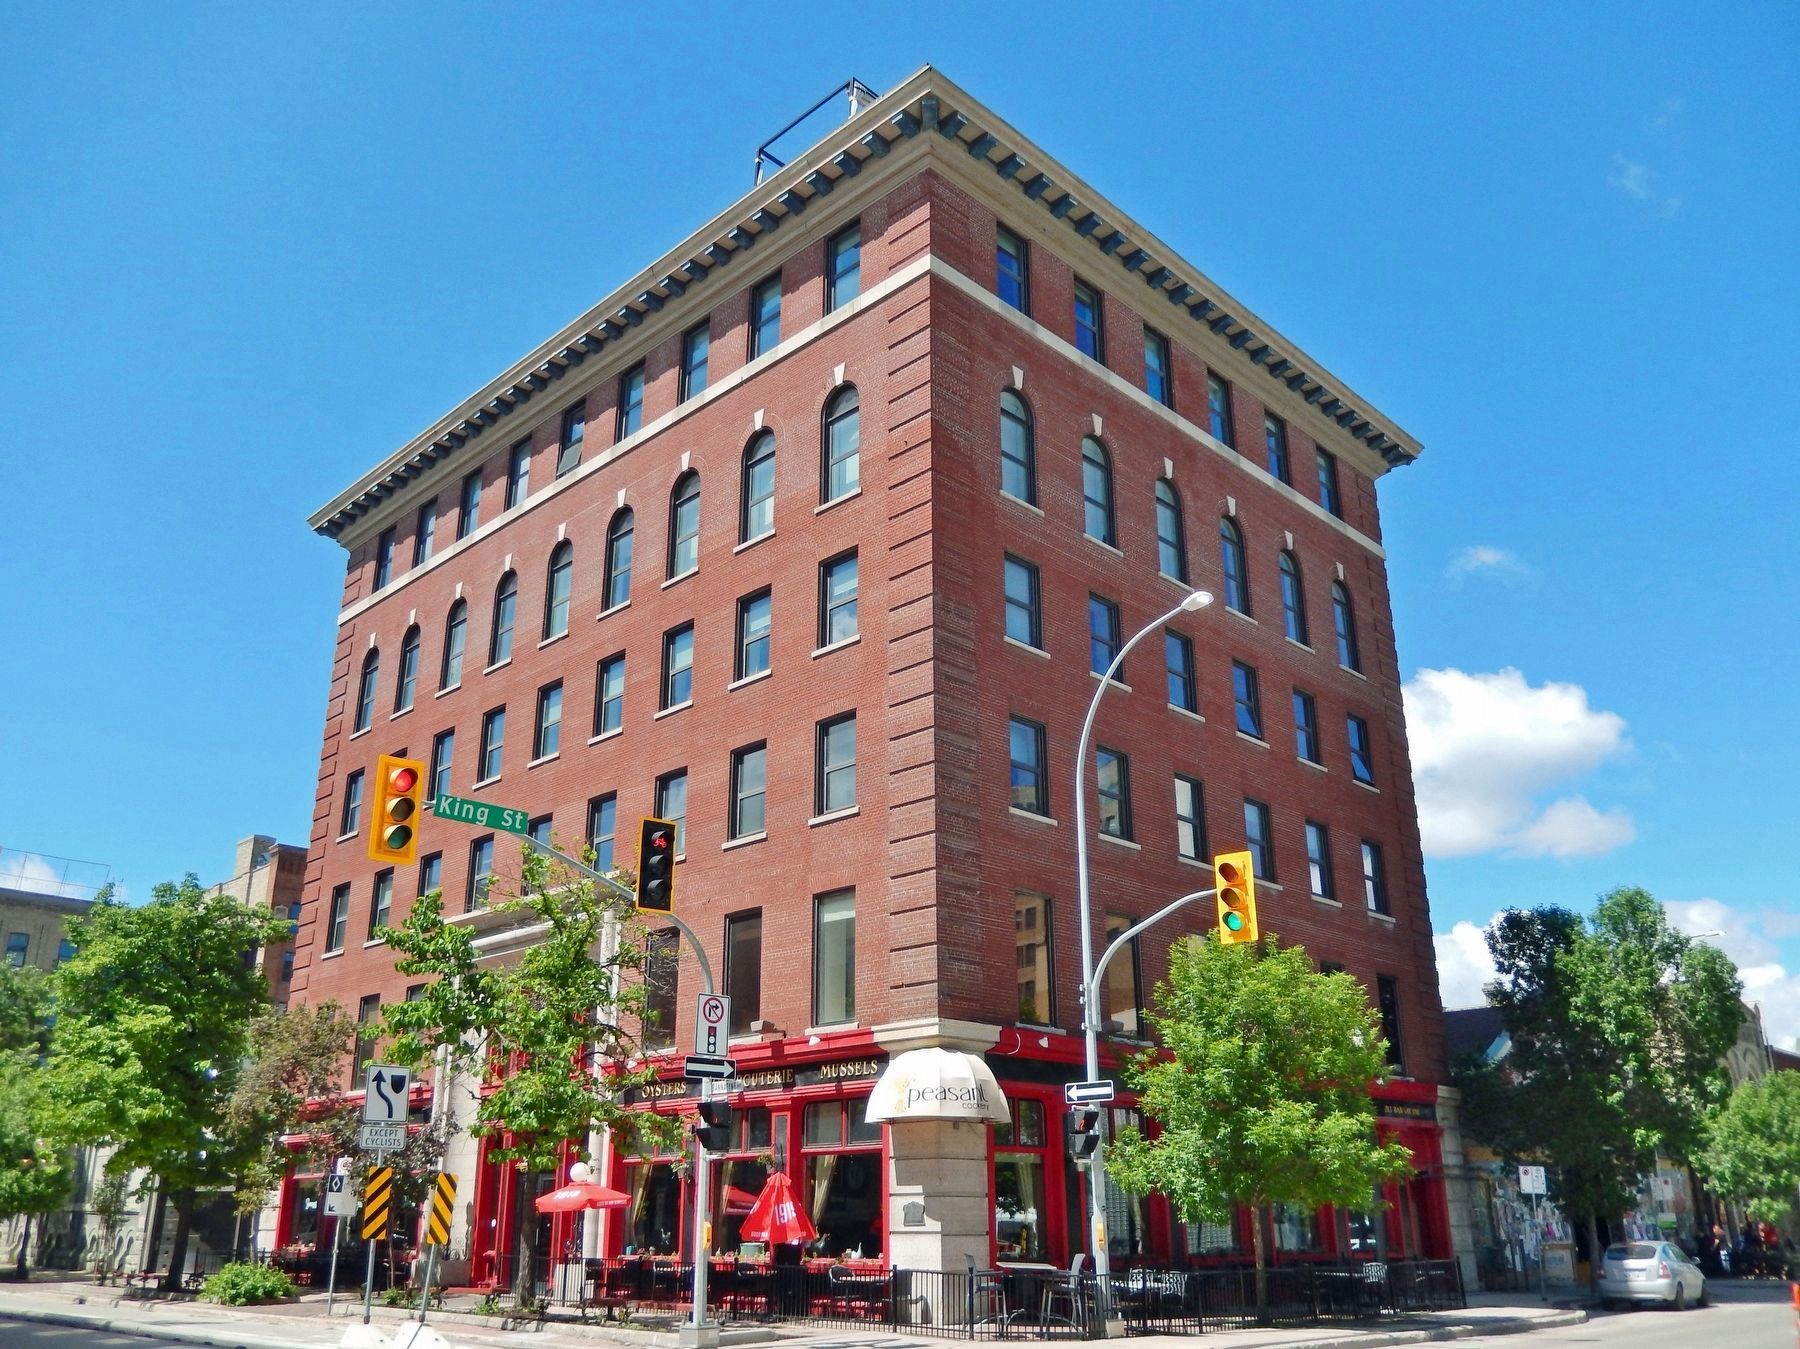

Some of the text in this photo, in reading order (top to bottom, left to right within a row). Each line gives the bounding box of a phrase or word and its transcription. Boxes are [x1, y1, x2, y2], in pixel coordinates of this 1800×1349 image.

[439, 796, 523, 829] King St
[820, 1059, 878, 1079] MUSSELS
[641, 1081, 687, 1098] OYSTERS
[908, 1083, 988, 1108] peasant
[370, 1128, 398, 1137] EXCEPT
[365, 1137, 401, 1147] CYCLISTS
